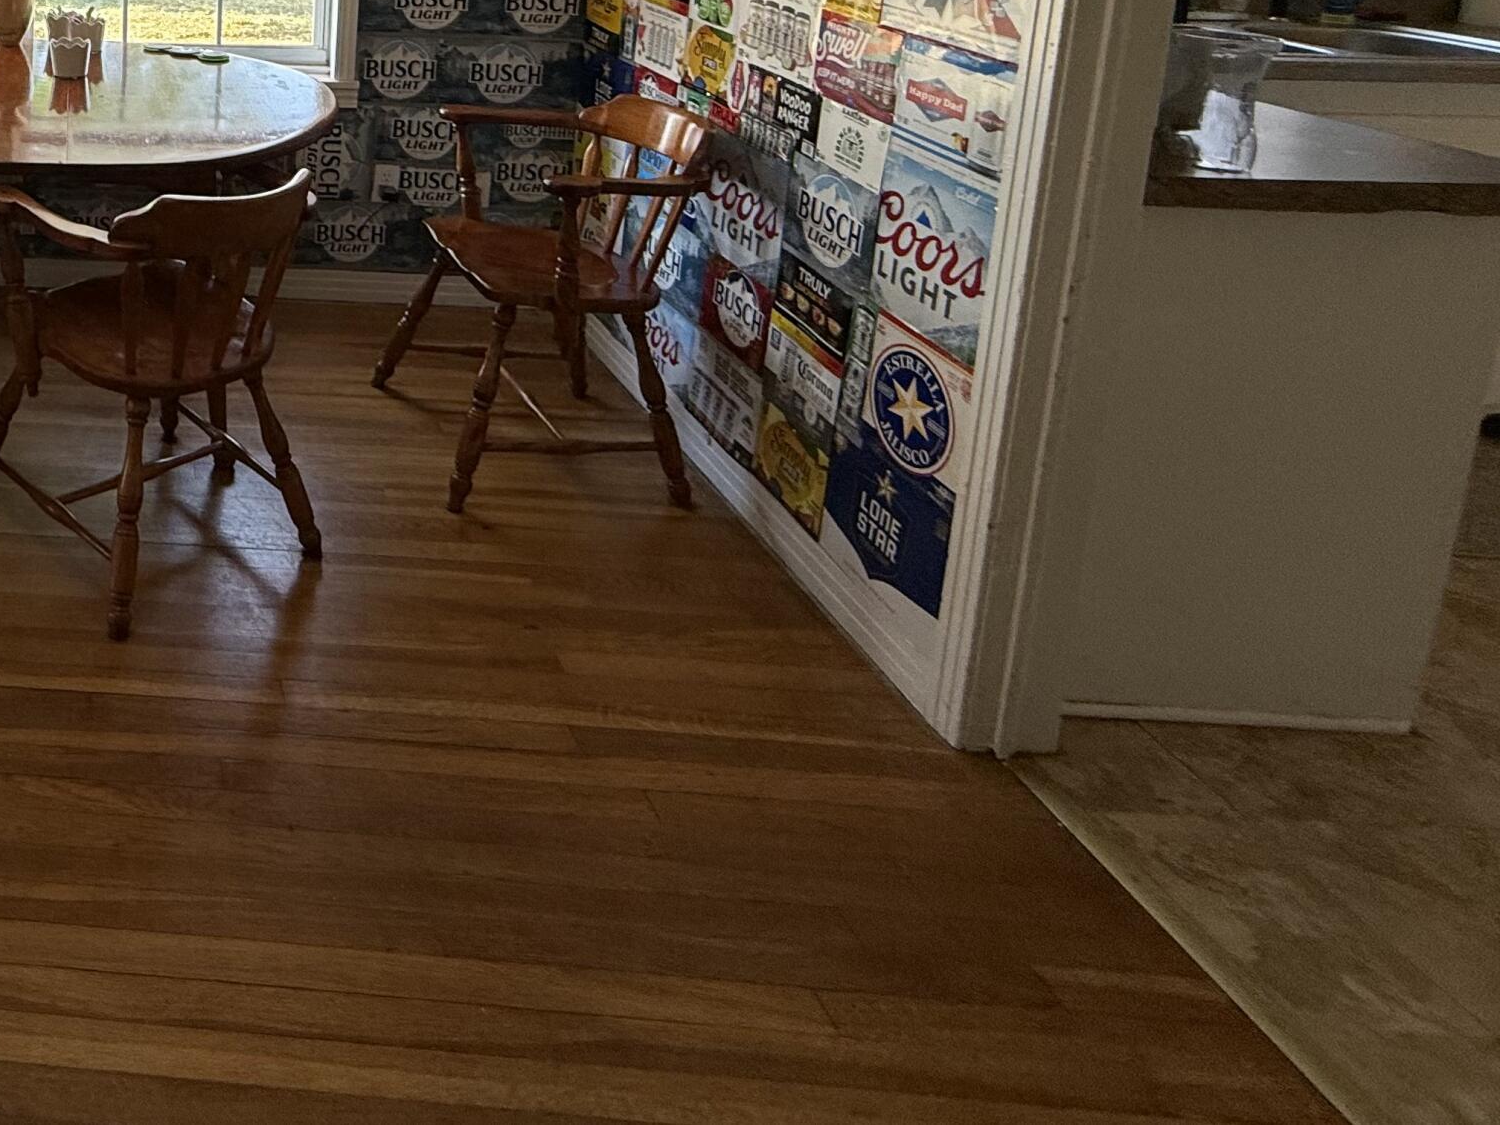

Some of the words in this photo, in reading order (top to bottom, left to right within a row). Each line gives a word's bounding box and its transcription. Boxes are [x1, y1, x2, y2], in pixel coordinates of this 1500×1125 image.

[410, 10, 452, 20] LIGHT
[814, 28, 870, 69] Swell
[777, 106, 811, 132] RANGER
[780, 87, 812, 116] VOODOO
[908, 84, 941, 108] Happy
[942, 97, 965, 115] Dad
[706, 158, 779, 240] Coors
[799, 189, 863, 255] BUSCH
[711, 206, 766, 258] LIGHT
[806, 228, 846, 260] LIGHT
[875, 190, 986, 299] Coors
[798, 267, 832, 300] TRULY
[877, 250, 958, 321] LIGHT
[714, 280, 764, 340] BUSCH
[883, 353, 946, 414] ESTRELLA
[856, 513, 899, 565] STAR
[859, 490, 902, 543] LONE
